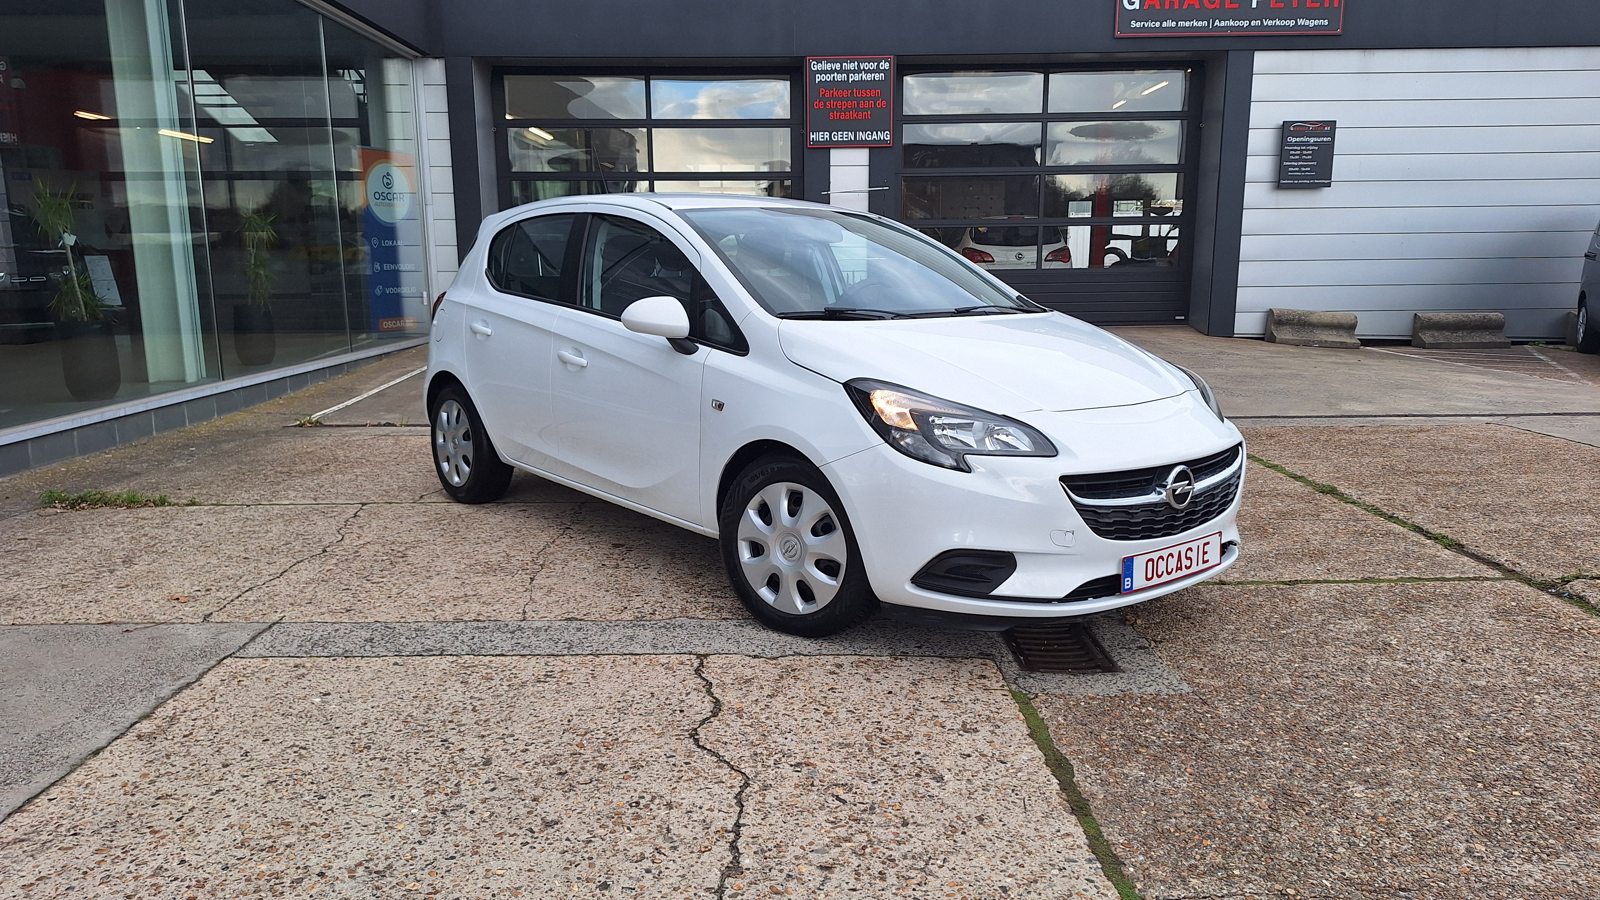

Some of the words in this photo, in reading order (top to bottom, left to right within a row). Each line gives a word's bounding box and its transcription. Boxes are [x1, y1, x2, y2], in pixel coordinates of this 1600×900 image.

[1130, 20, 1160, 28] Service
[1162, 19, 1177, 28] alle
[1178, 19, 1208, 27] merken
[1214, 19, 1249, 28] Aankoop
[1251, 19, 1261, 27] en
[1262, 18, 1296, 28] Verkoop
[1297, 18, 1329, 28] Wagens
[810, 60, 841, 71] Gelieve
[842, 59, 858, 71] niet
[860, 61, 877, 70] voor
[879, 59, 890, 70] de
[815, 72, 847, 84] poorten
[849, 71, 885, 83] parkeren
[819, 88, 853, 98] Parkeer
[853, 88, 881, 97] tussen
[813, 99, 824, 109] de
[826, 99, 857, 110] strepen
[859, 100, 874, 108] aan
[876, 98, 887, 108] de
[829, 109, 871, 120] straatkant
[810, 131, 830, 141] HIER
[831, 131, 855, 141] GEEN
[856, 130, 890, 141] INGANG
[373, 191, 405, 202] OSCAR
[1145, 541, 1210, 582] OCCASIE
[1124, 577, 1132, 589] B
